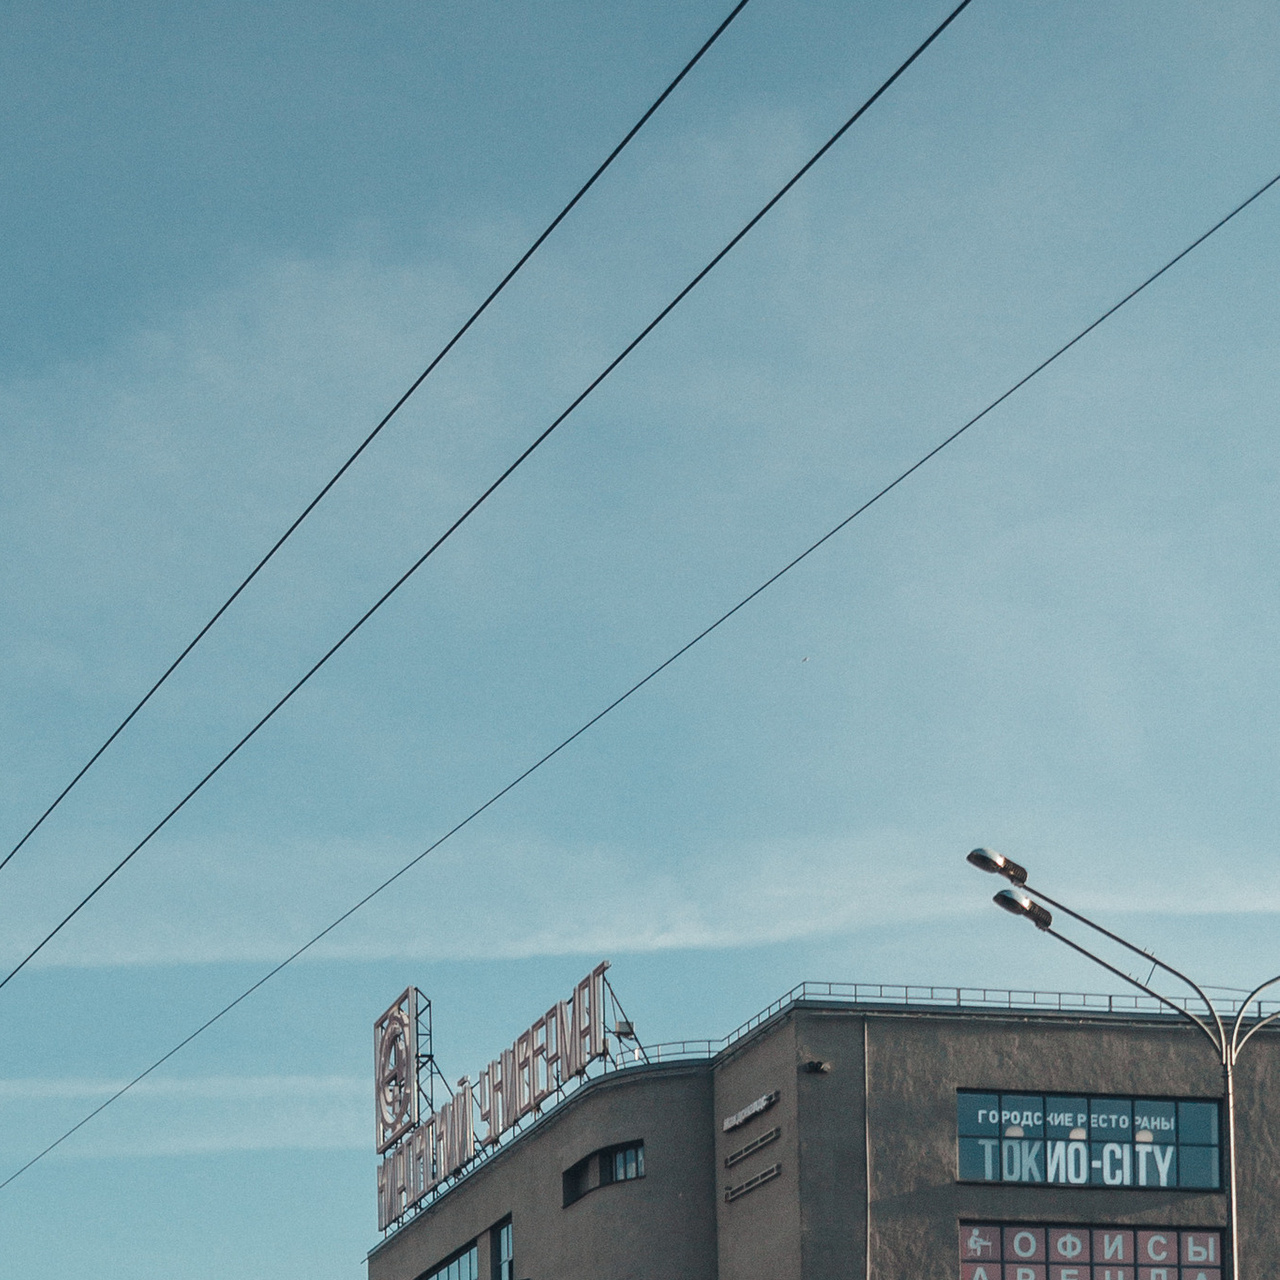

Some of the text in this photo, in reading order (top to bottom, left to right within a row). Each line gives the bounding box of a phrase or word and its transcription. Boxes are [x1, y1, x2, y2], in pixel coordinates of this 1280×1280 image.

[977, 1109, 1175, 1131] ГОРОДСКИЕ РЕСТОРАНЫ
[1013, 1231, 1215, 1262] ОФИСЫ
